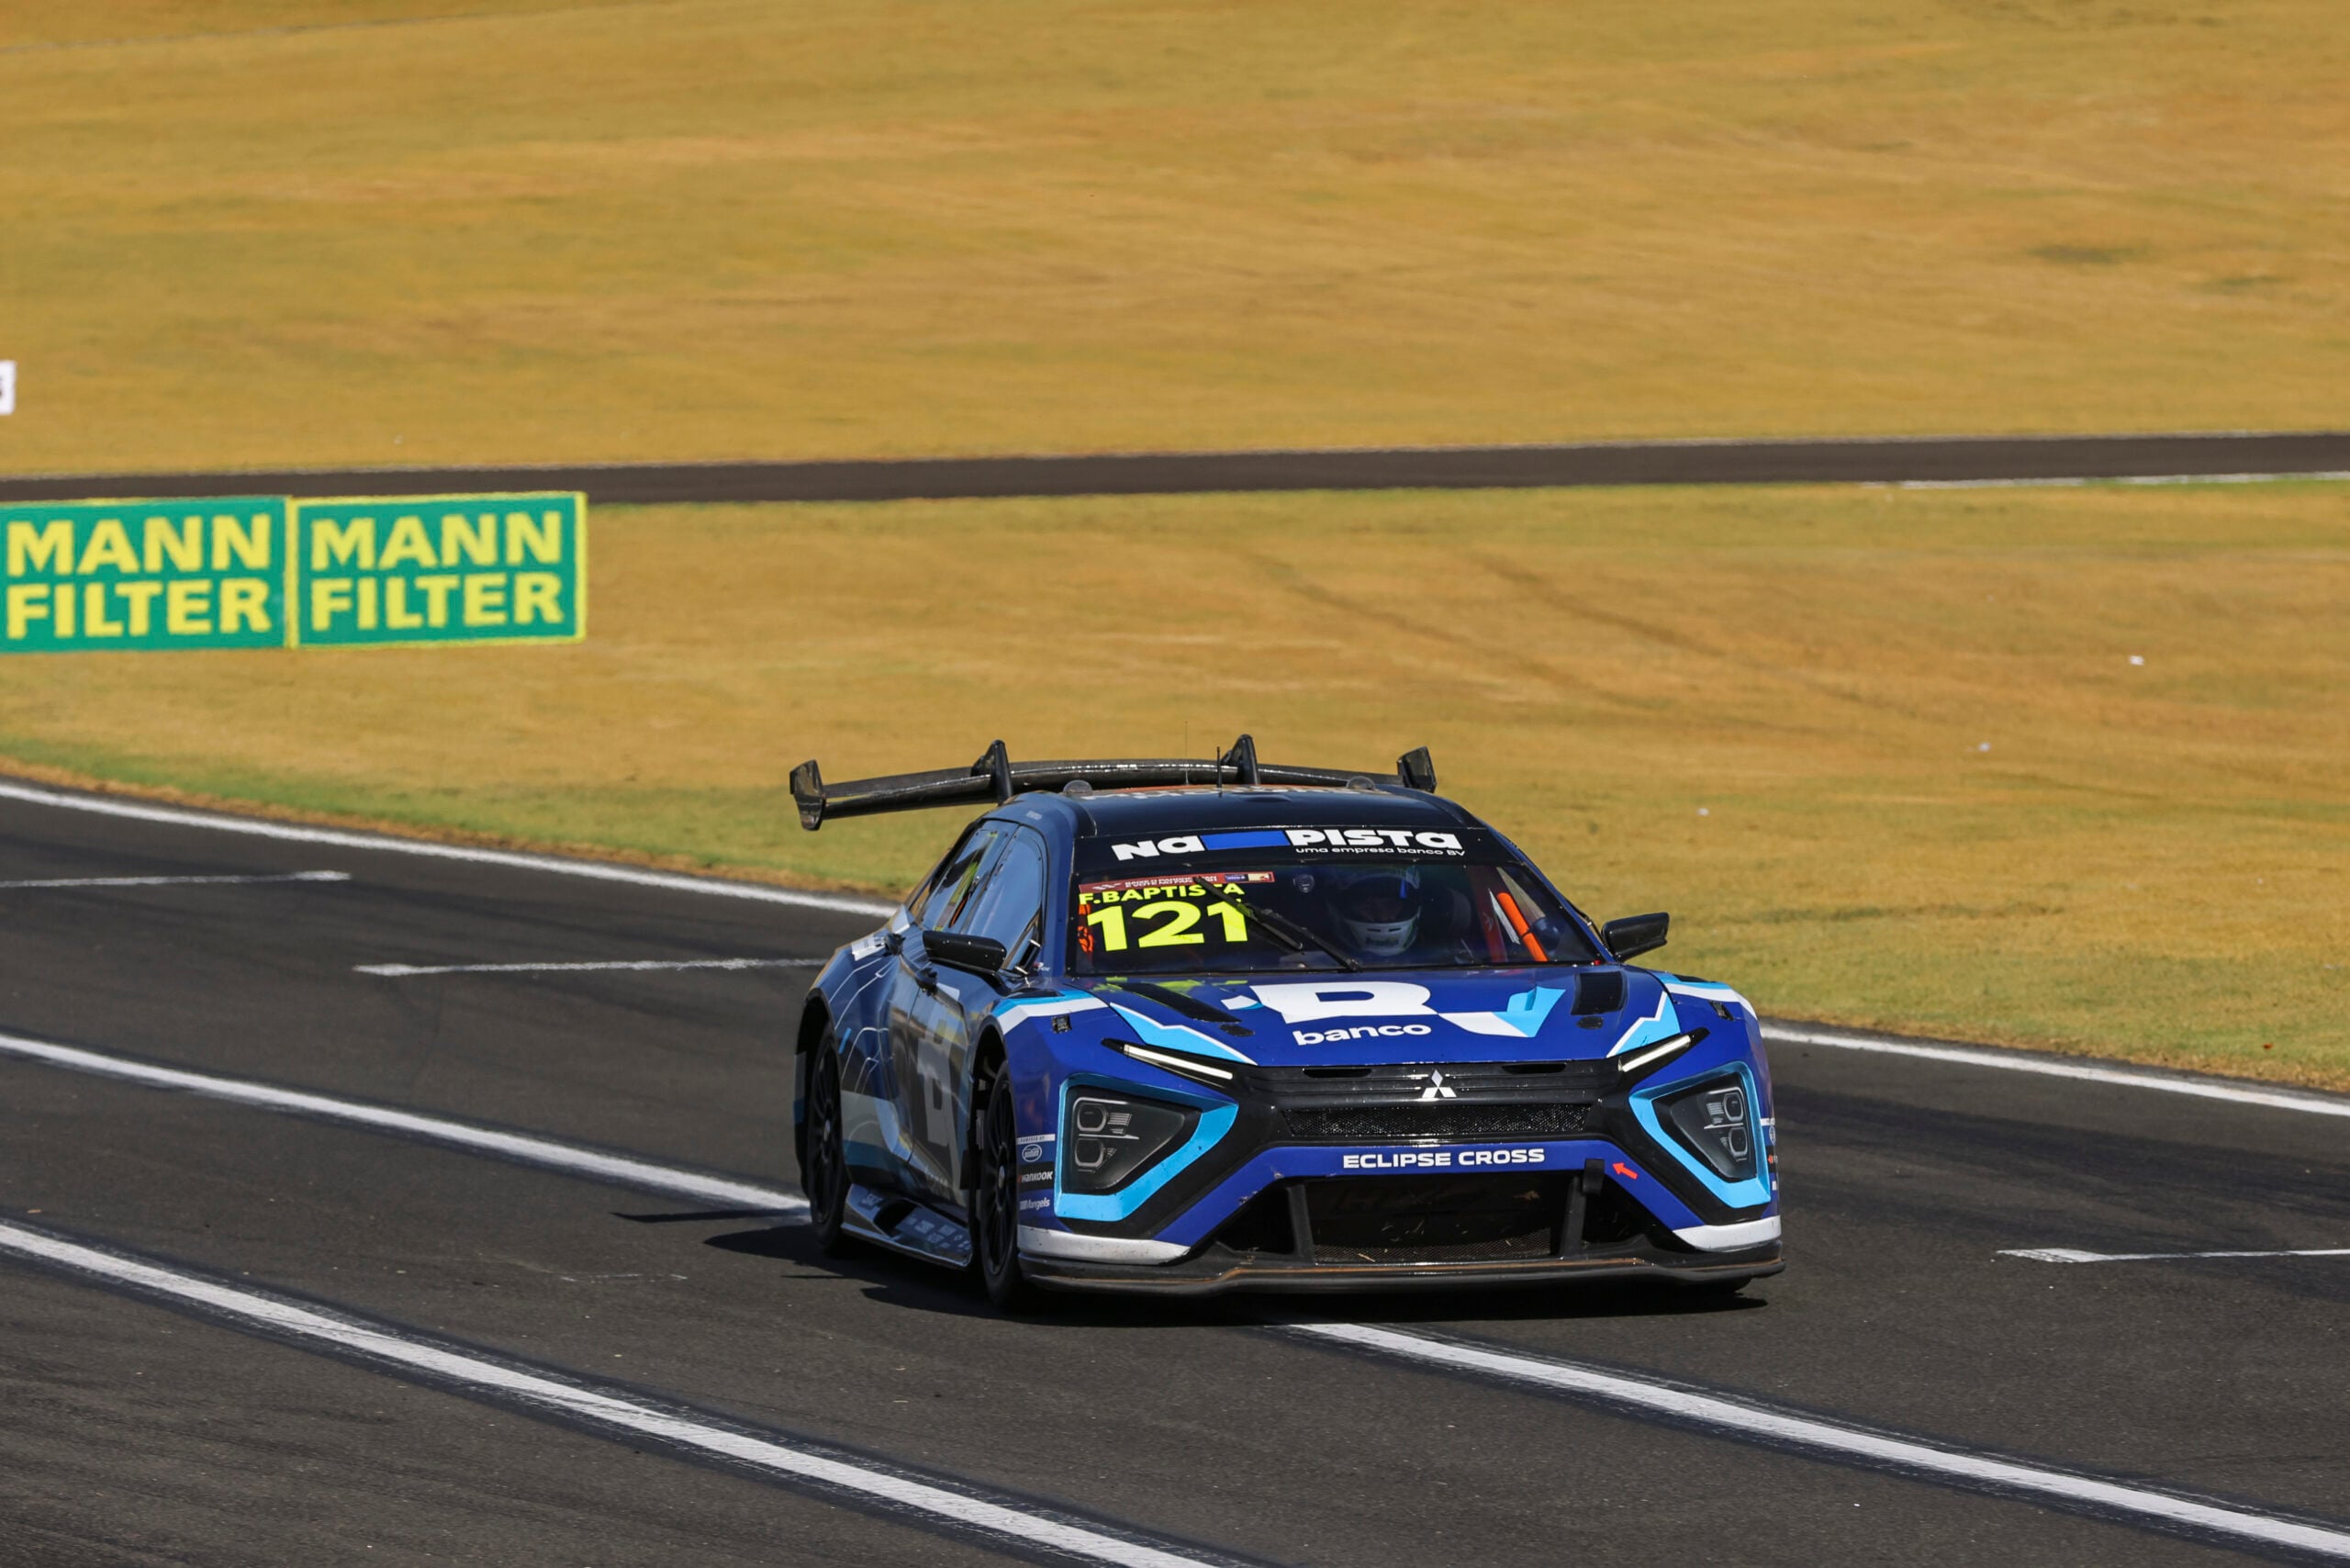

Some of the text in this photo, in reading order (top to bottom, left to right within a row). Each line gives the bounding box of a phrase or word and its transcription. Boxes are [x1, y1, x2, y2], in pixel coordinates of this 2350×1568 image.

[7, 514, 272, 577] MANN
[311, 511, 562, 570] MANN
[6, 578, 272, 640] FILTER
[311, 573, 564, 631] FILTER
[1332, 846, 1394, 855] empresa
[1397, 846, 1444, 856] banco
[1079, 882, 1245, 905] F.BAPTISA
[1087, 901, 1248, 952] 121
[1292, 1025, 1432, 1046] banco
[1343, 1148, 1545, 1169] ECLIPSE CROSS
